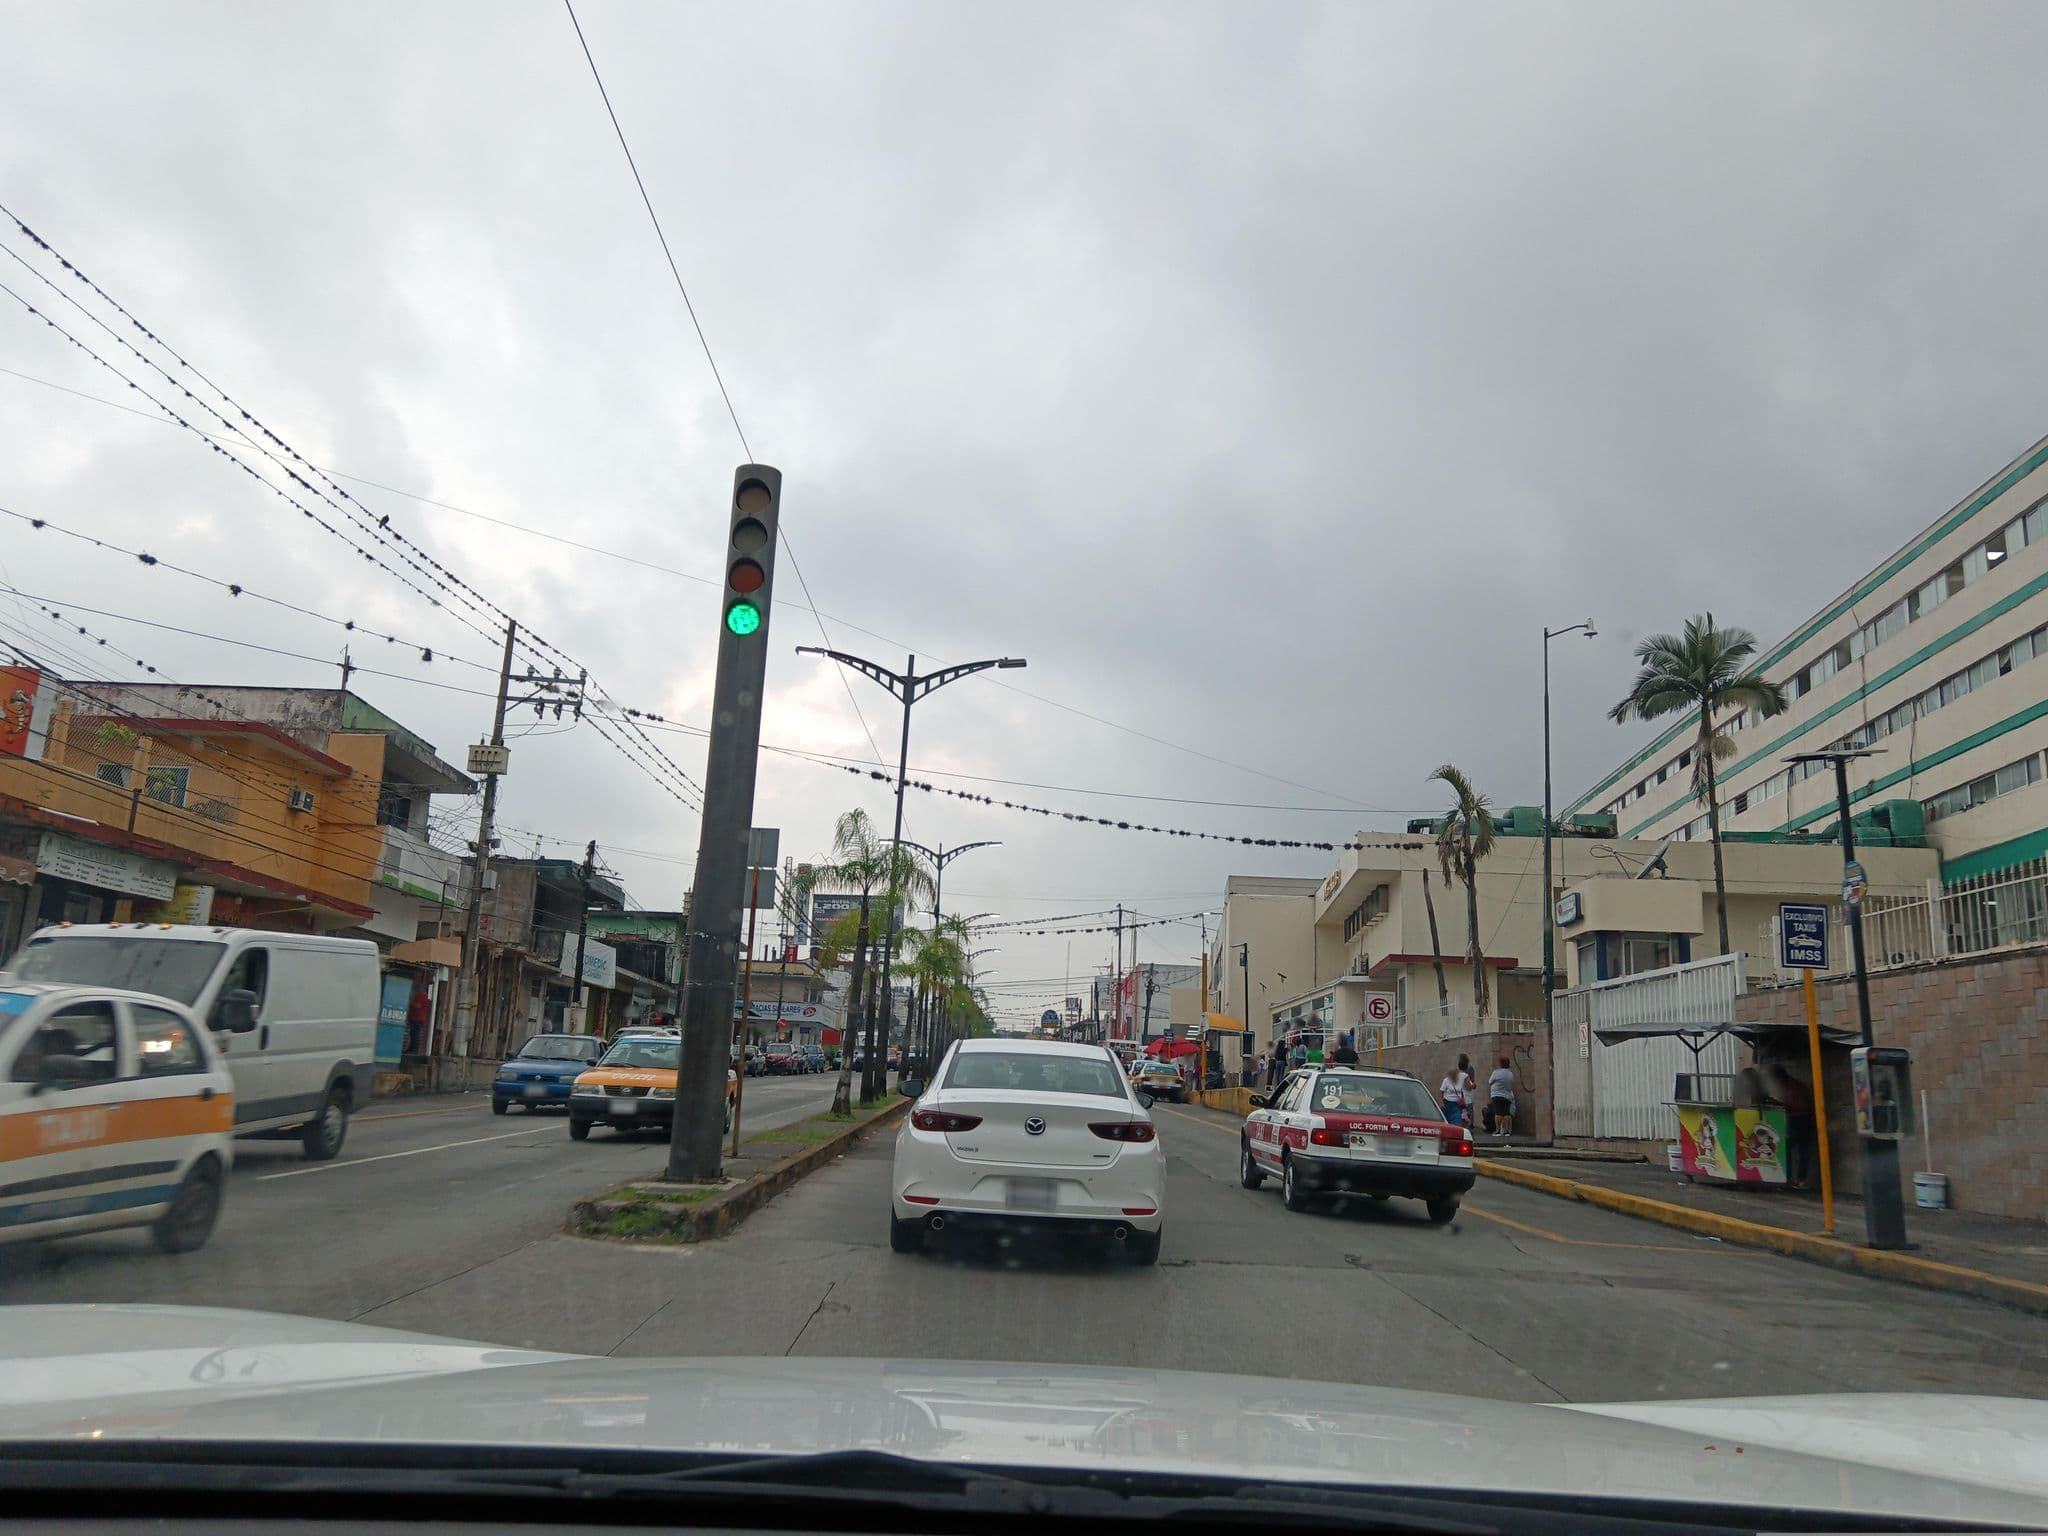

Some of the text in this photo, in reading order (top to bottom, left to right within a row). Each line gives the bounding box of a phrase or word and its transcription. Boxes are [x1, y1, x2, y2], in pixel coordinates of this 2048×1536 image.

[1785, 912, 1824, 922] EXCLUSIVO
[1792, 922, 1817, 933] TAXIS
[1790, 949, 1822, 961] IMSS
[1323, 1085, 1343, 1096] 191
[1349, 1122, 1389, 1131] LOC. FORTIN
[1402, 1126, 1420, 1134] MPIO.
